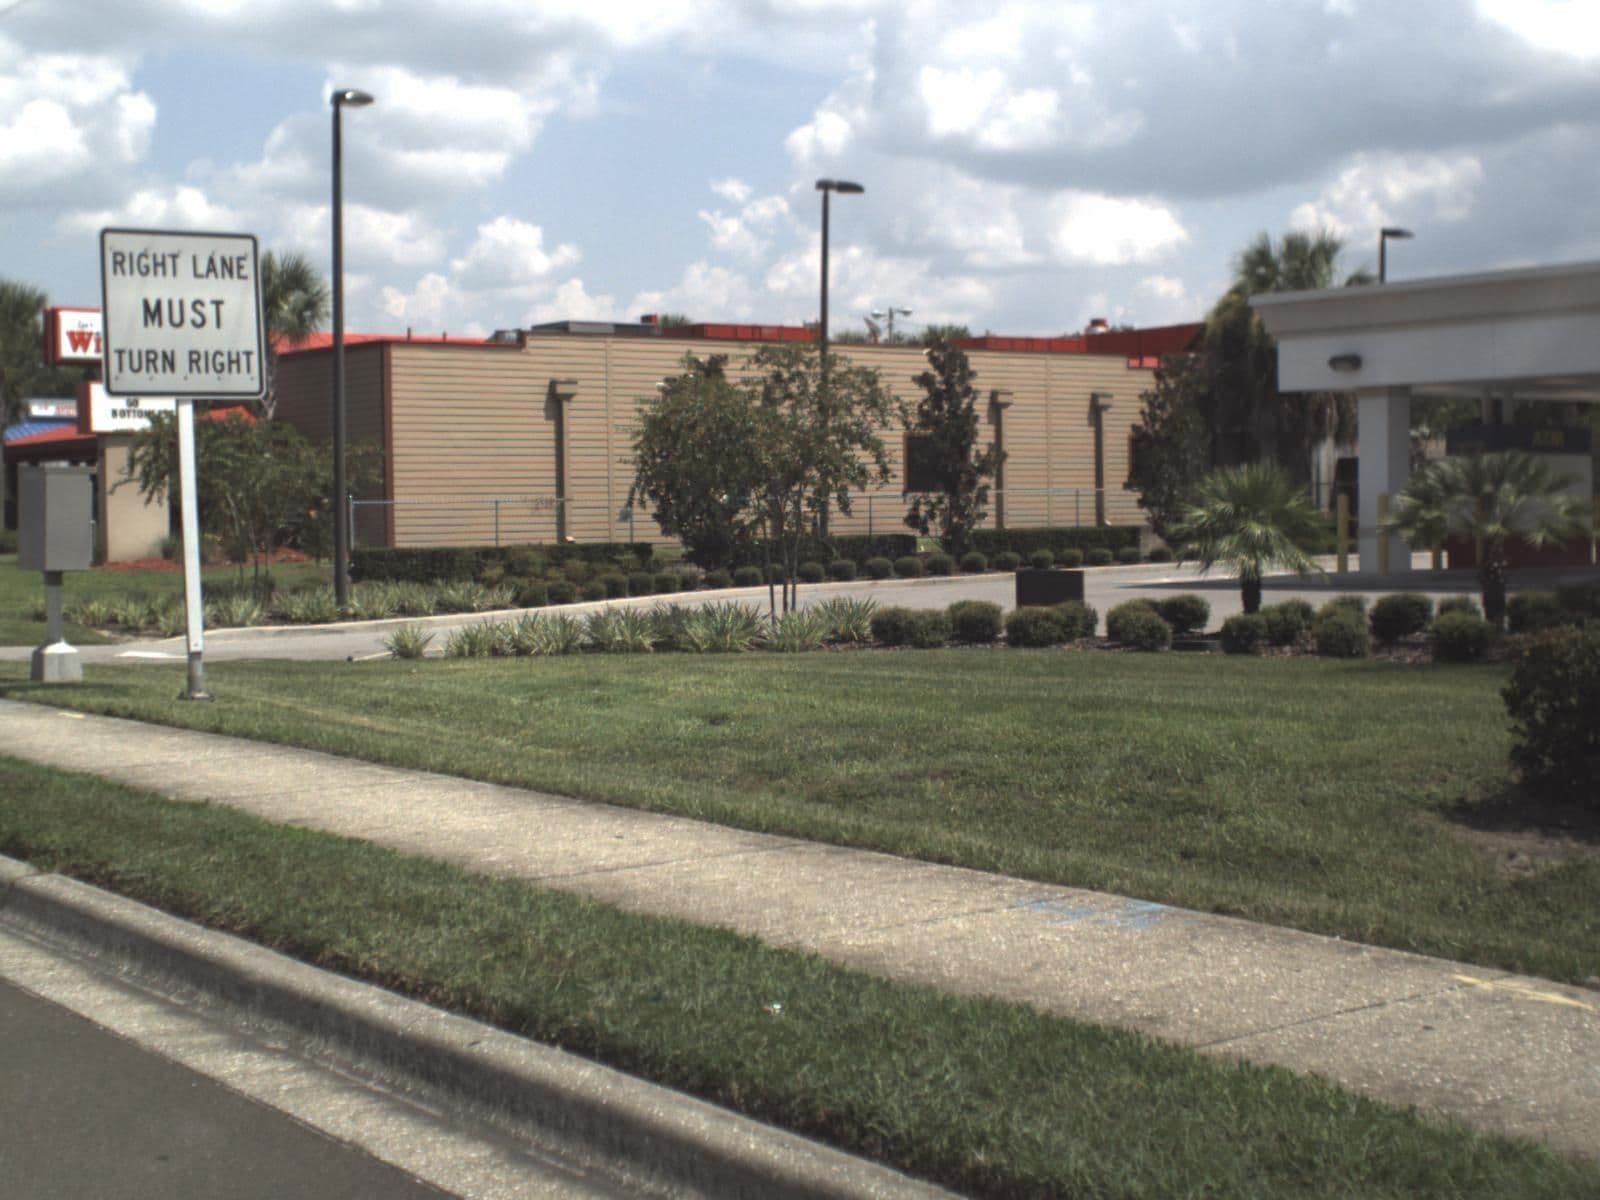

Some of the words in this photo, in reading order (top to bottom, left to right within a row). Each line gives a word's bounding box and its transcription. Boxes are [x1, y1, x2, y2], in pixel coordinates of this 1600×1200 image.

[112, 251, 179, 277] RIGHT
[192, 254, 248, 280] LANE
[142, 298, 225, 329] MUST
[114, 349, 176, 374] TURN
[188, 351, 254, 374] RIGHT
